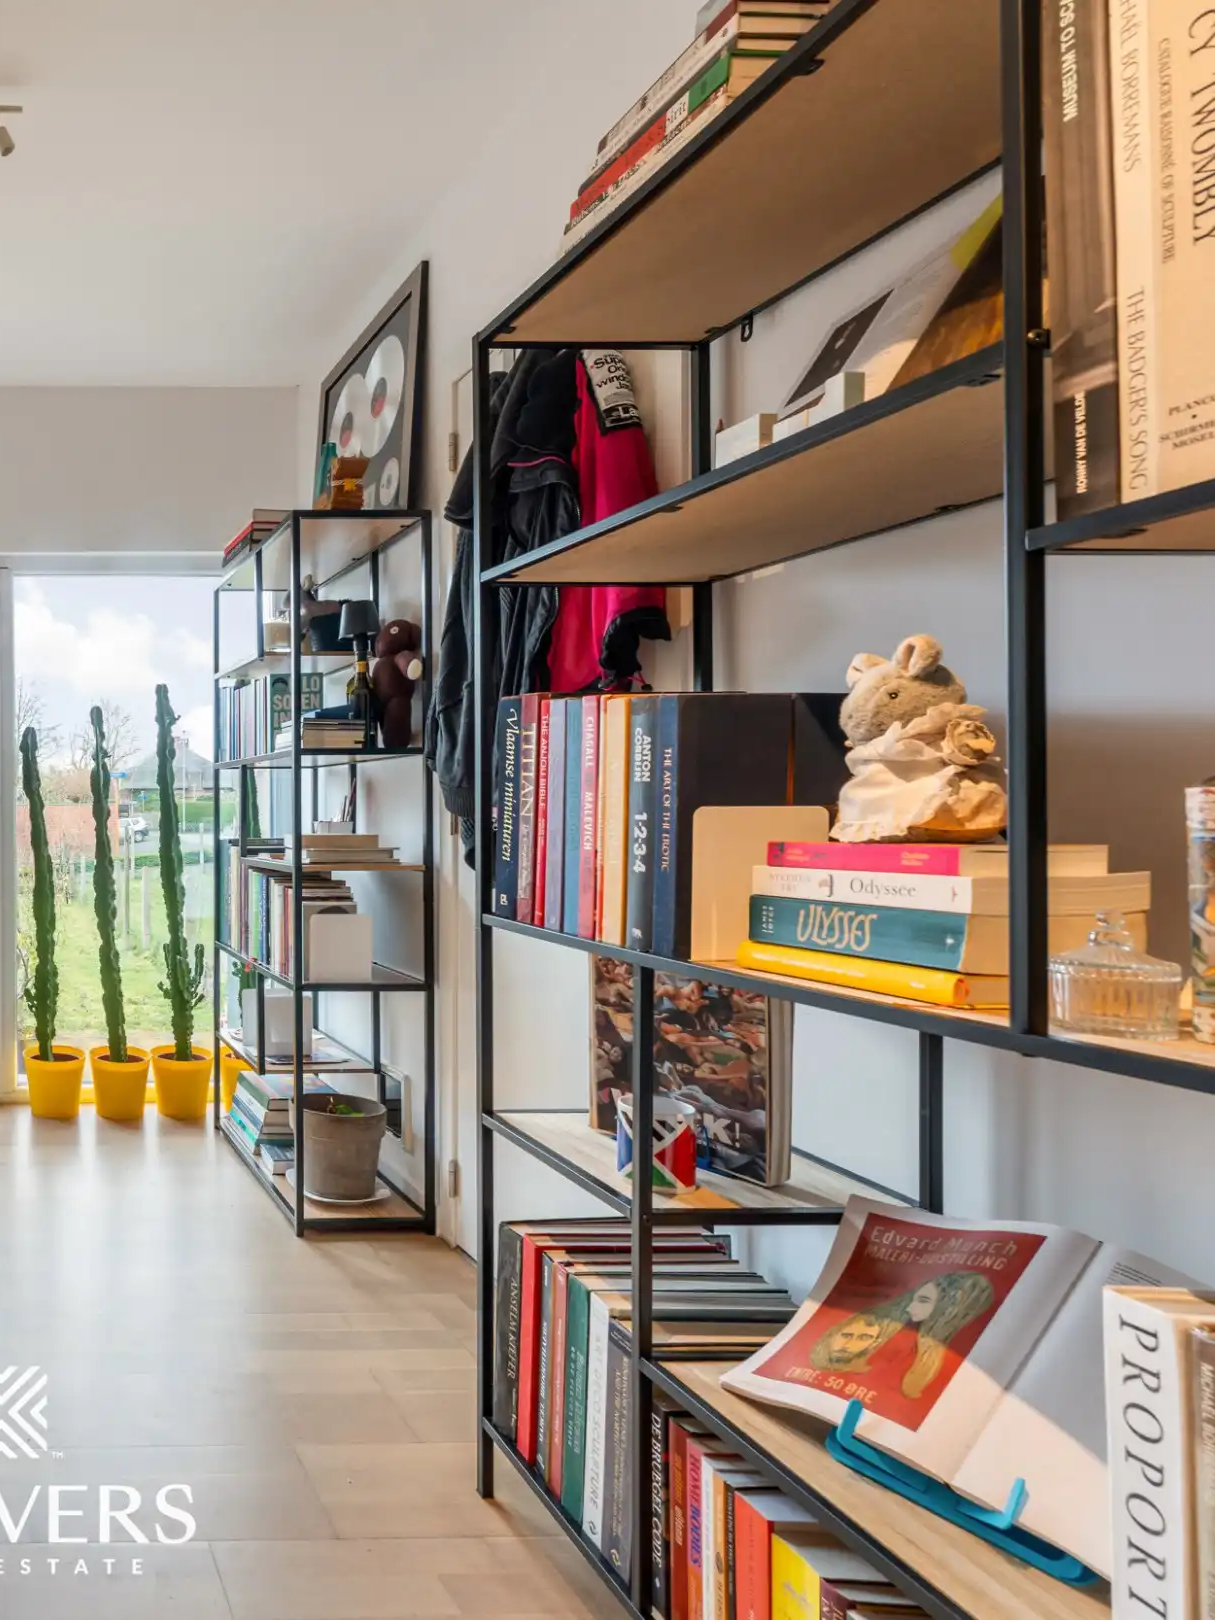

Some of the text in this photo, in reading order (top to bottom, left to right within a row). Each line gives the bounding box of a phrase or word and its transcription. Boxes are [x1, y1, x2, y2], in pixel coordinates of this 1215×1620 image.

[1060, 27, 1076, 49] TO
[1062, 52, 1079, 123] MUSEUM
[1161, 174, 1173, 190] OF
[1126, 288, 1149, 491] THE BADGER'S SONG
[1075, 423, 1086, 437] DE
[1075, 438, 1087, 461] VAN
[520, 722, 536, 817] TITIAN
[537, 714, 549, 810] THE ANJOU BIBLE
[583, 716, 595, 851] CHAGALL MALEVICH
[633, 727, 643, 782] CORBIJN
[642, 734, 652, 782] ANTON
[502, 707, 520, 862] Vlaamse miniaturen
[660, 748, 673, 874] THE ART OF THE EROTIC
[632, 811, 648, 874] 1-2-3-4
[849, 877, 917, 898] Odyssee
[767, 905, 775, 934] JOYCE
[796, 903, 879, 952] ULYSSES
[871, 1225, 1018, 1256] Edvard Munch
[506, 1277, 521, 1380] ANSELM KIEFER
[823, 1376, 845, 1390] 50
[843, 1382, 878, 1404] ØRE
[588, 1335, 603, 1512] ART DECO SCULPTURE
[651, 1412, 663, 1567] DE BRUEGEL CODE
